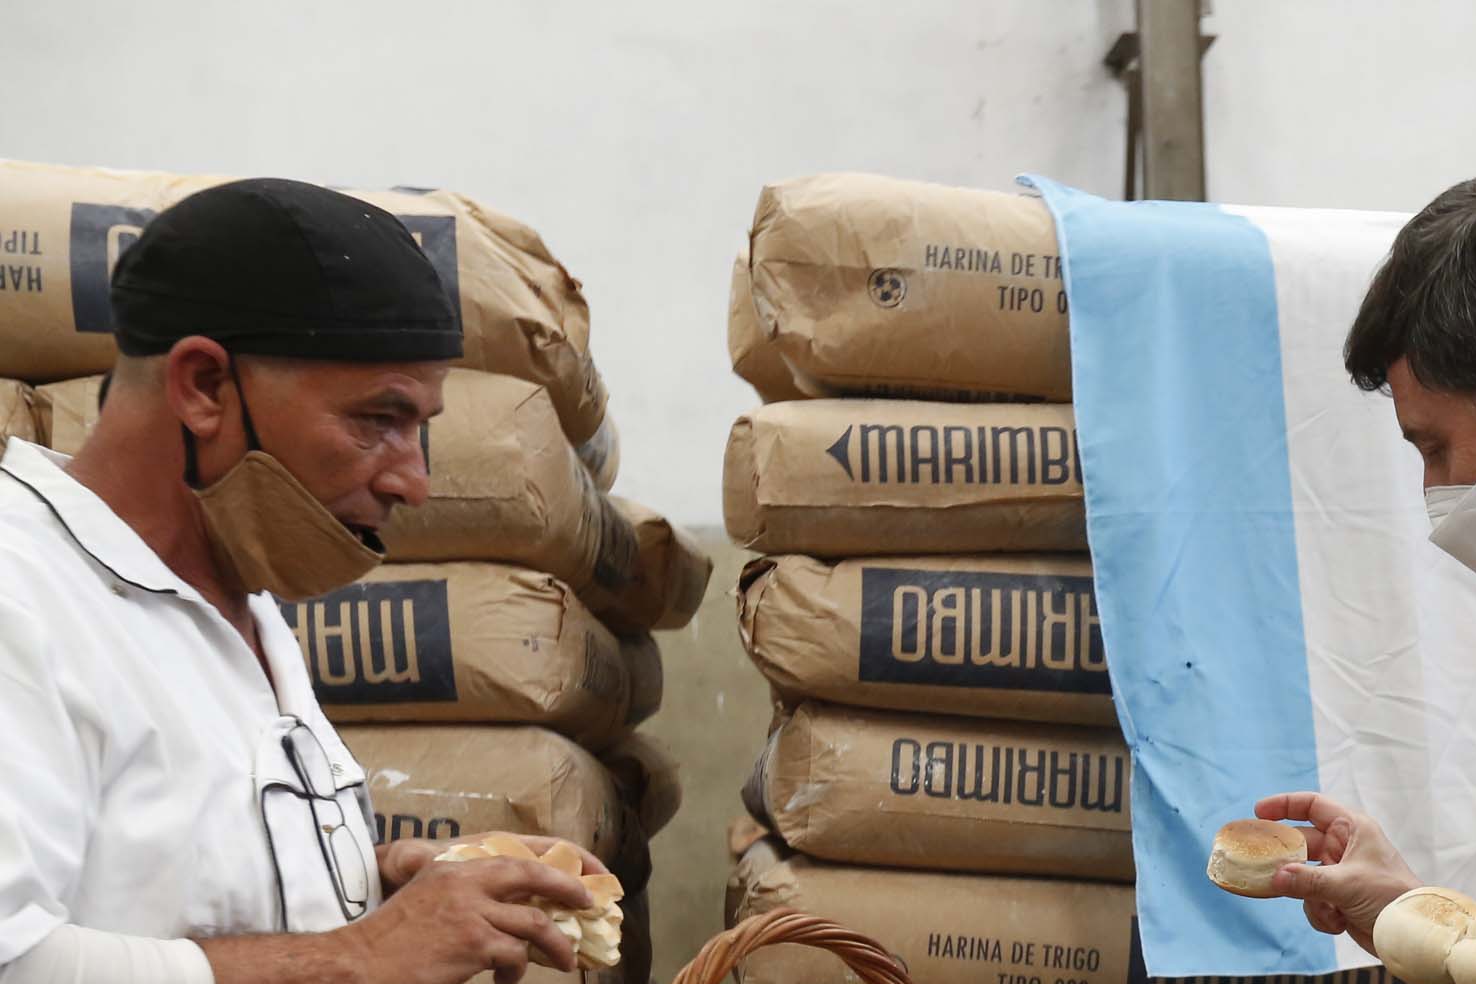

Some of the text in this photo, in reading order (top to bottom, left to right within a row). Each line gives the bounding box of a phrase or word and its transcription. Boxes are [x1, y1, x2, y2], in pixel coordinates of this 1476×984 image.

[925, 244, 1002, 274] HARINA
[1011, 253, 1036, 277] DE
[997, 285, 1044, 314] TIPO
[860, 423, 1083, 485] MARIMB
[890, 737, 1124, 814] MARIMBO
[927, 933, 1101, 973] HARINA DE TRIGO
